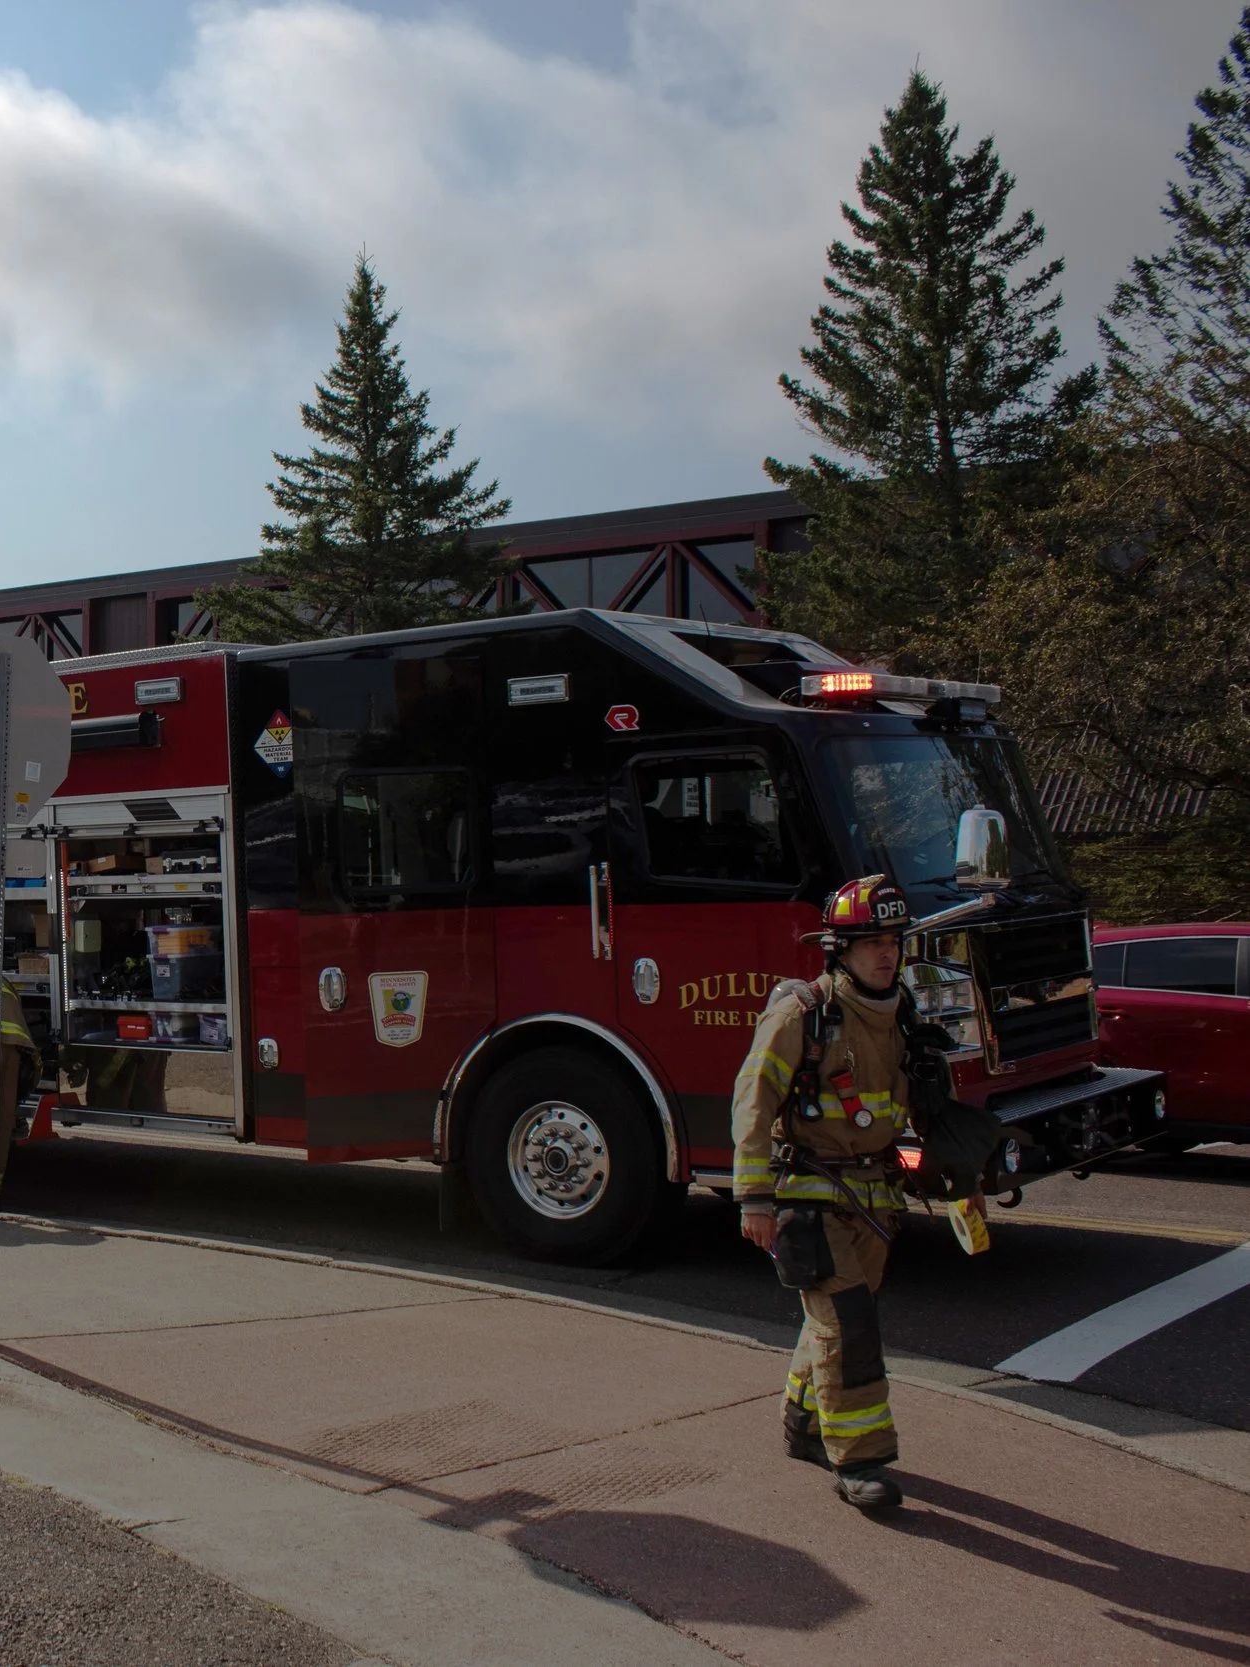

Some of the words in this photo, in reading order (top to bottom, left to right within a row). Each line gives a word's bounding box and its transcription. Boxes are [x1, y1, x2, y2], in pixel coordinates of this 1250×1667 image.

[876, 900, 906, 919] DFD
[678, 972, 790, 1010] DULU
[693, 1010, 741, 1026] FIRE
